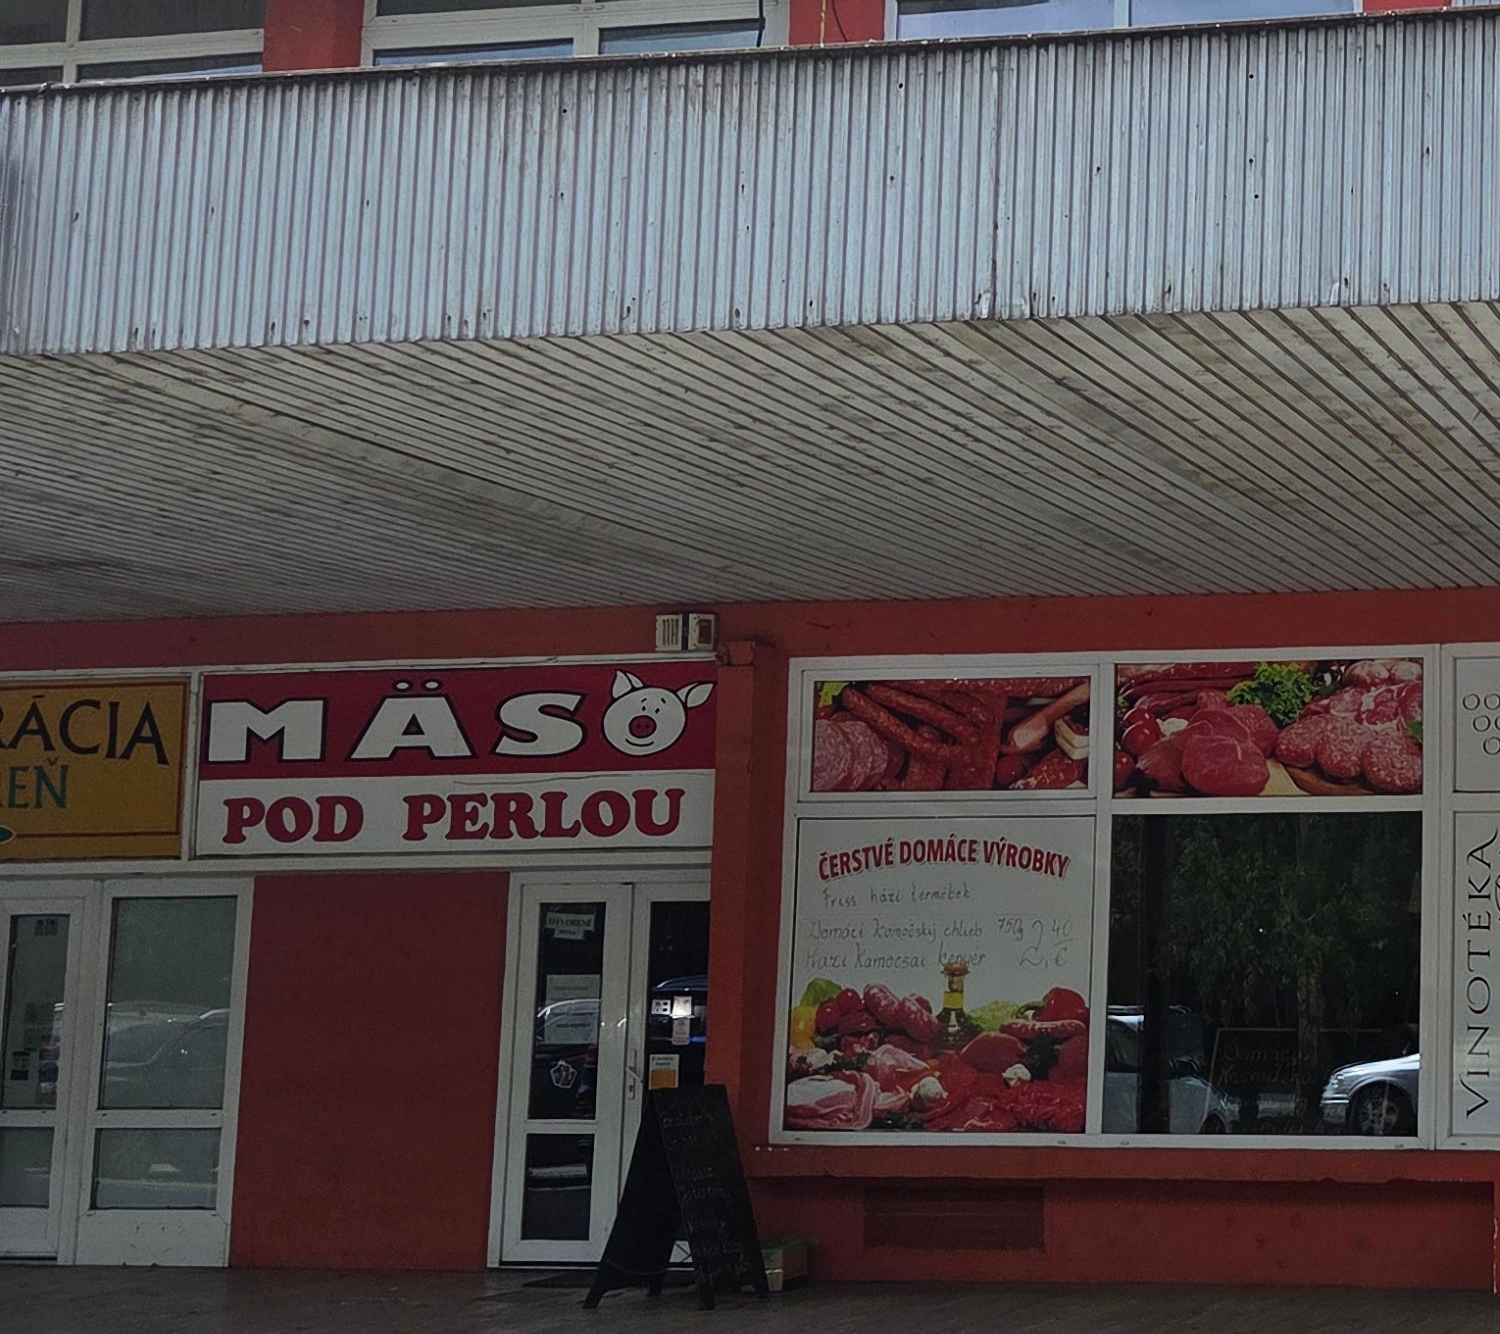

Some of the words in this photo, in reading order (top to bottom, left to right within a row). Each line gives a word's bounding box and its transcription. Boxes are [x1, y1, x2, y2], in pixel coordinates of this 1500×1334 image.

[0, 695, 170, 766] ÁCIA
[222, 794, 364, 844] POD
[402, 788, 686, 842] PERLOU
[818, 837, 895, 881] ČERSTVÉ
[900, 834, 977, 864] DOMÁCE
[983, 837, 1071, 878] VÝROBKY
[1460, 827, 1498, 1120] VINOTÉKA
